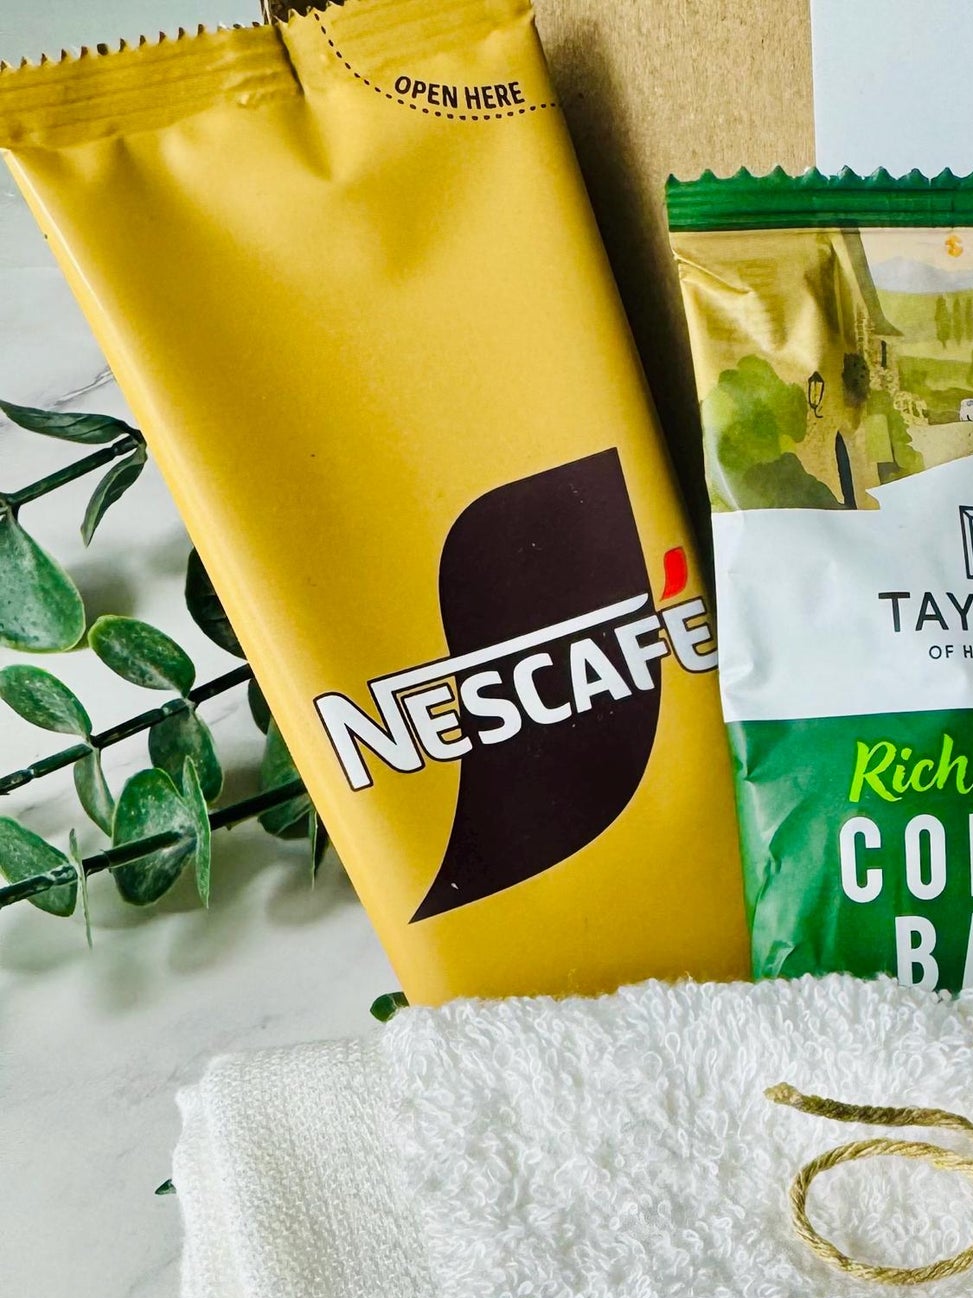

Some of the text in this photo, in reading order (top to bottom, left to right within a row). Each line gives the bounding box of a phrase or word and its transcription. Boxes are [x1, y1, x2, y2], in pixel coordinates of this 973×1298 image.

[394, 76, 526, 110] OPEN HERE
[313, 545, 719, 792] NESCAFÉ
[928, 644, 954, 660] OF
